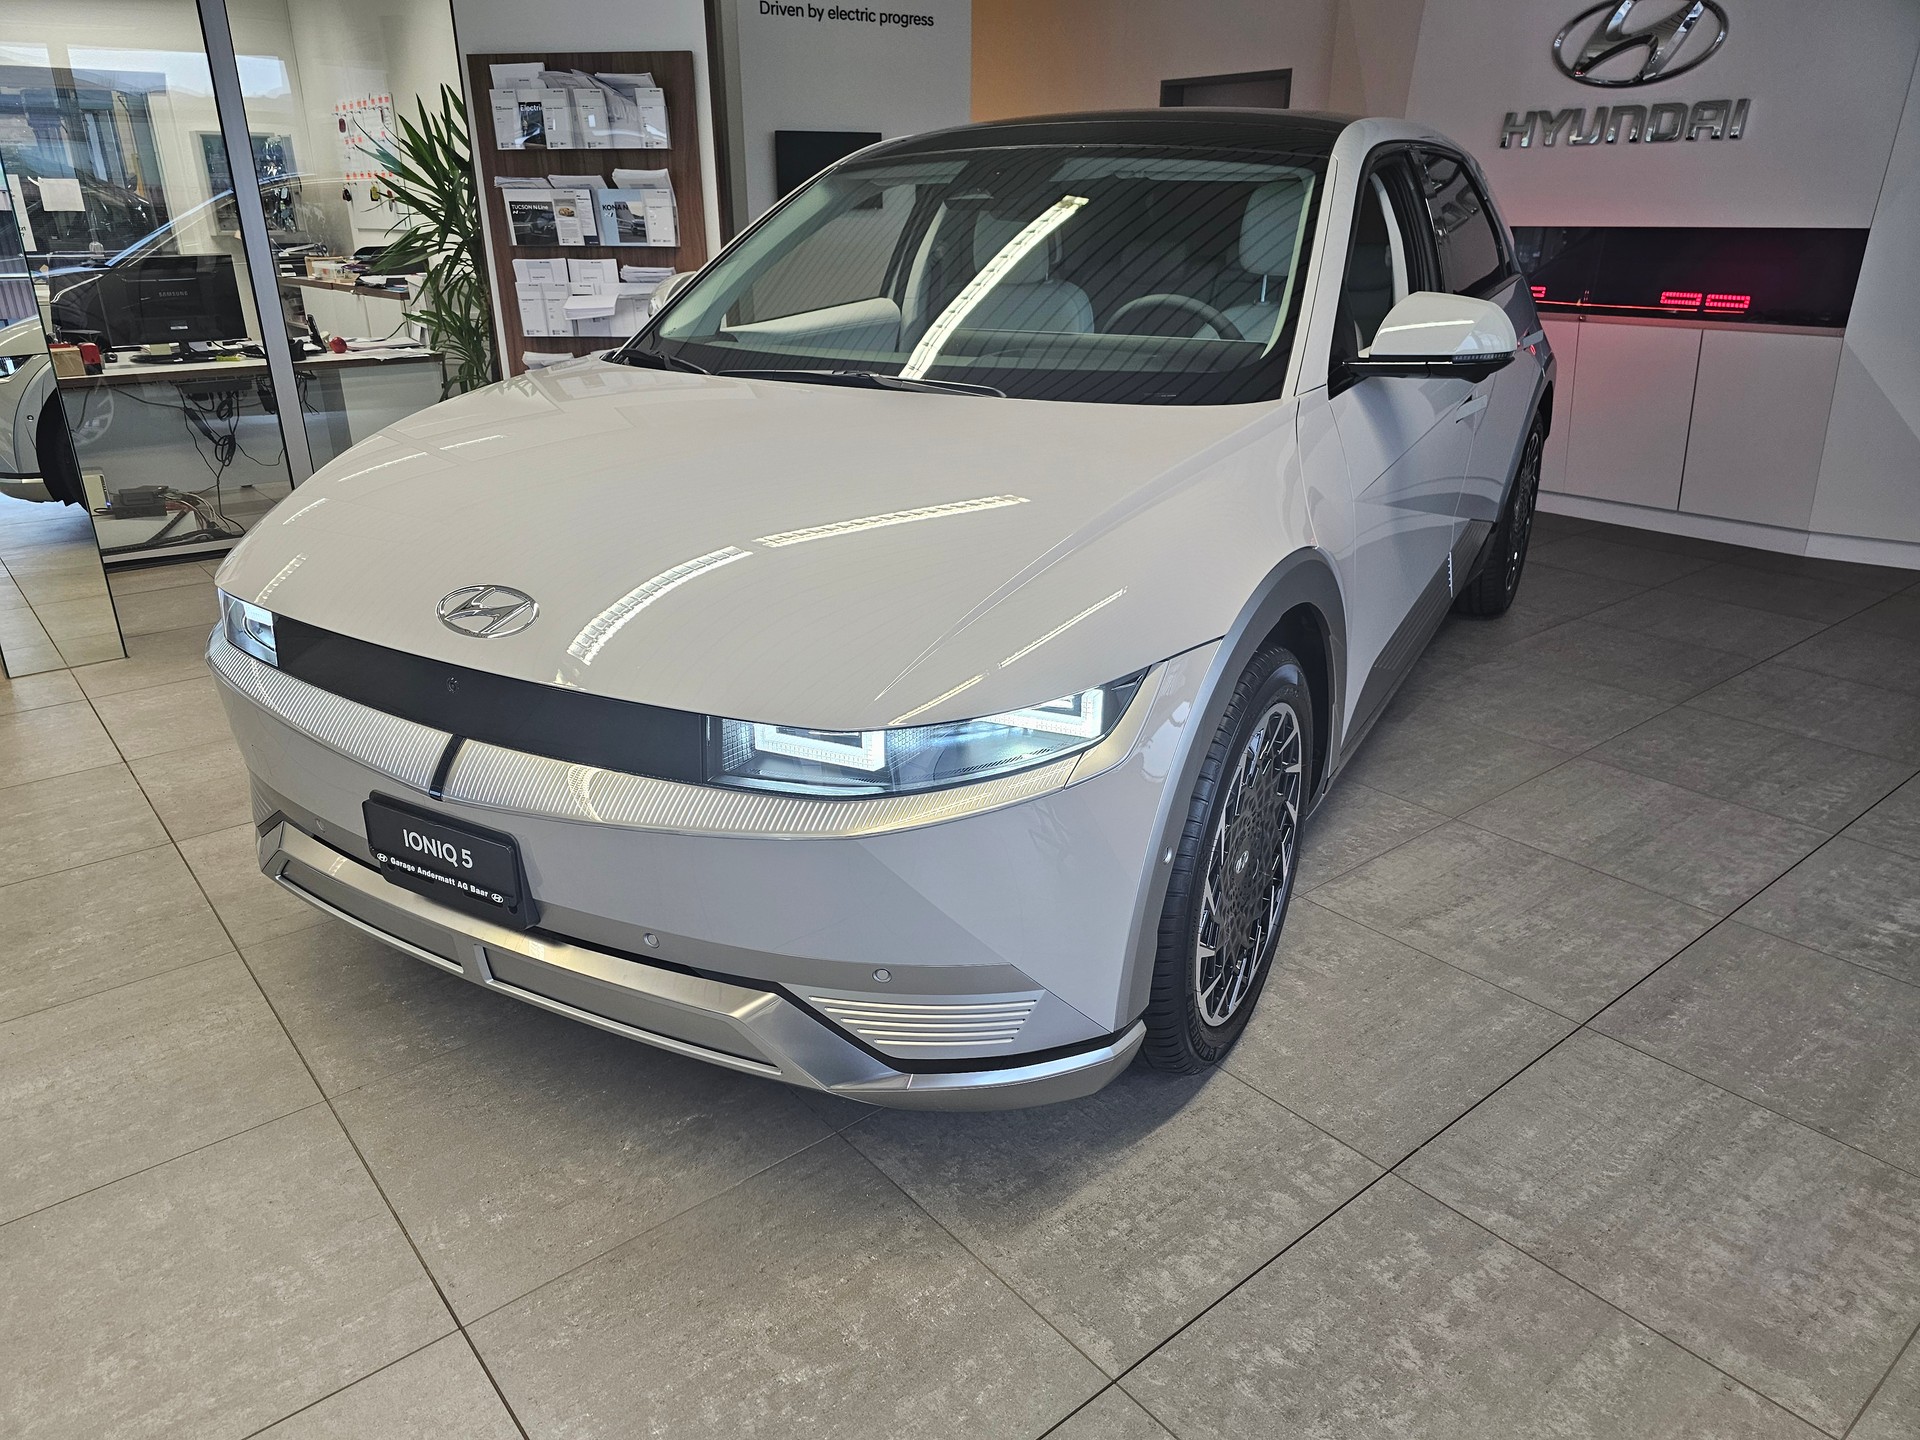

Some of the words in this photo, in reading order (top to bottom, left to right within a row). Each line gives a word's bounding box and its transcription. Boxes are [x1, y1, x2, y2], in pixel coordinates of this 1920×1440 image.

[759, 0, 804, 17] Driven
[808, 4, 824, 22] by
[828, 6, 876, 23] electric
[879, 12, 934, 28] progress
[1499, 99, 1751, 148] HYUNDAI
[402, 828, 458, 868] IONIQ
[461, 848, 474, 869] 5
[390, 857, 416, 872] Garage
[417, 867, 456, 886] Andermatt
[457, 879, 469, 891] AG
[1187, 1000, 1210, 1058] MICHELIN
